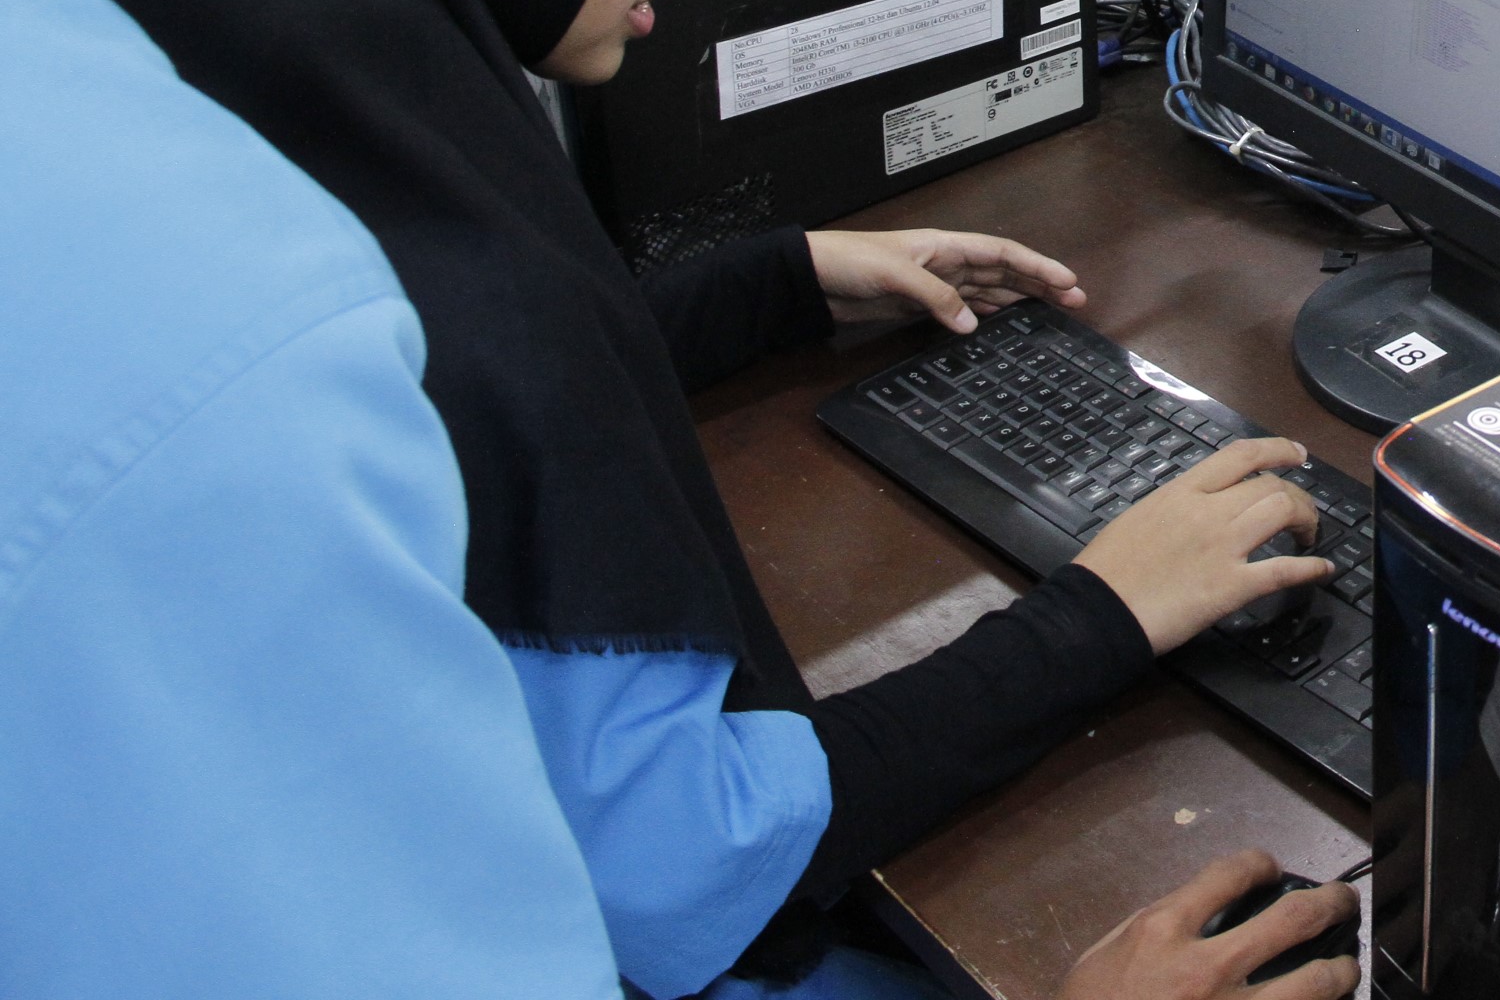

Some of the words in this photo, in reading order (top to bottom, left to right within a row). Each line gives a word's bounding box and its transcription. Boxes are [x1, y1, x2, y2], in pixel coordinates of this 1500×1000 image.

[792, 33, 821, 44] Windows
[828, 19, 866, 34] Professional
[899, 5, 922, 15] Ubuntu
[790, 25, 798, 35] 28
[820, 36, 837, 47] RAM
[792, 52, 817, 64] Intel(R)
[818, 43, 850, 57] Core(TM)
[877, 31, 892, 40] CPU
[734, 51, 746, 60] OS
[735, 59, 763, 70] Memory
[805, 62, 816, 70] Gb
[736, 67, 768, 80] Processor
[792, 73, 816, 83] Lenovo
[737, 77, 766, 90] Harddisk
[794, 82, 812, 92] AMD
[813, 71, 852, 87] ATOMBIOS
[737, 89, 762, 100] System
[763, 81, 784, 92] Model
[738, 99, 755, 108] VGA
[1395, 340, 1428, 368] 18
[975, 380, 987, 388] A
[1018, 375, 1030, 384] W
[997, 392, 1008, 400] S
[1039, 388, 1051, 396] E
[958, 400, 971, 408] Z
[1061, 402, 1073, 410] R
[979, 413, 991, 422] X
[1084, 415, 1095, 423] T
[1039, 420, 1051, 428] F
[1107, 429, 1118, 437] Y
[1023, 442, 1036, 450] V
[1084, 448, 1096, 456] H
[1044, 456, 1057, 464] B
[1130, 477, 1142, 485] K
